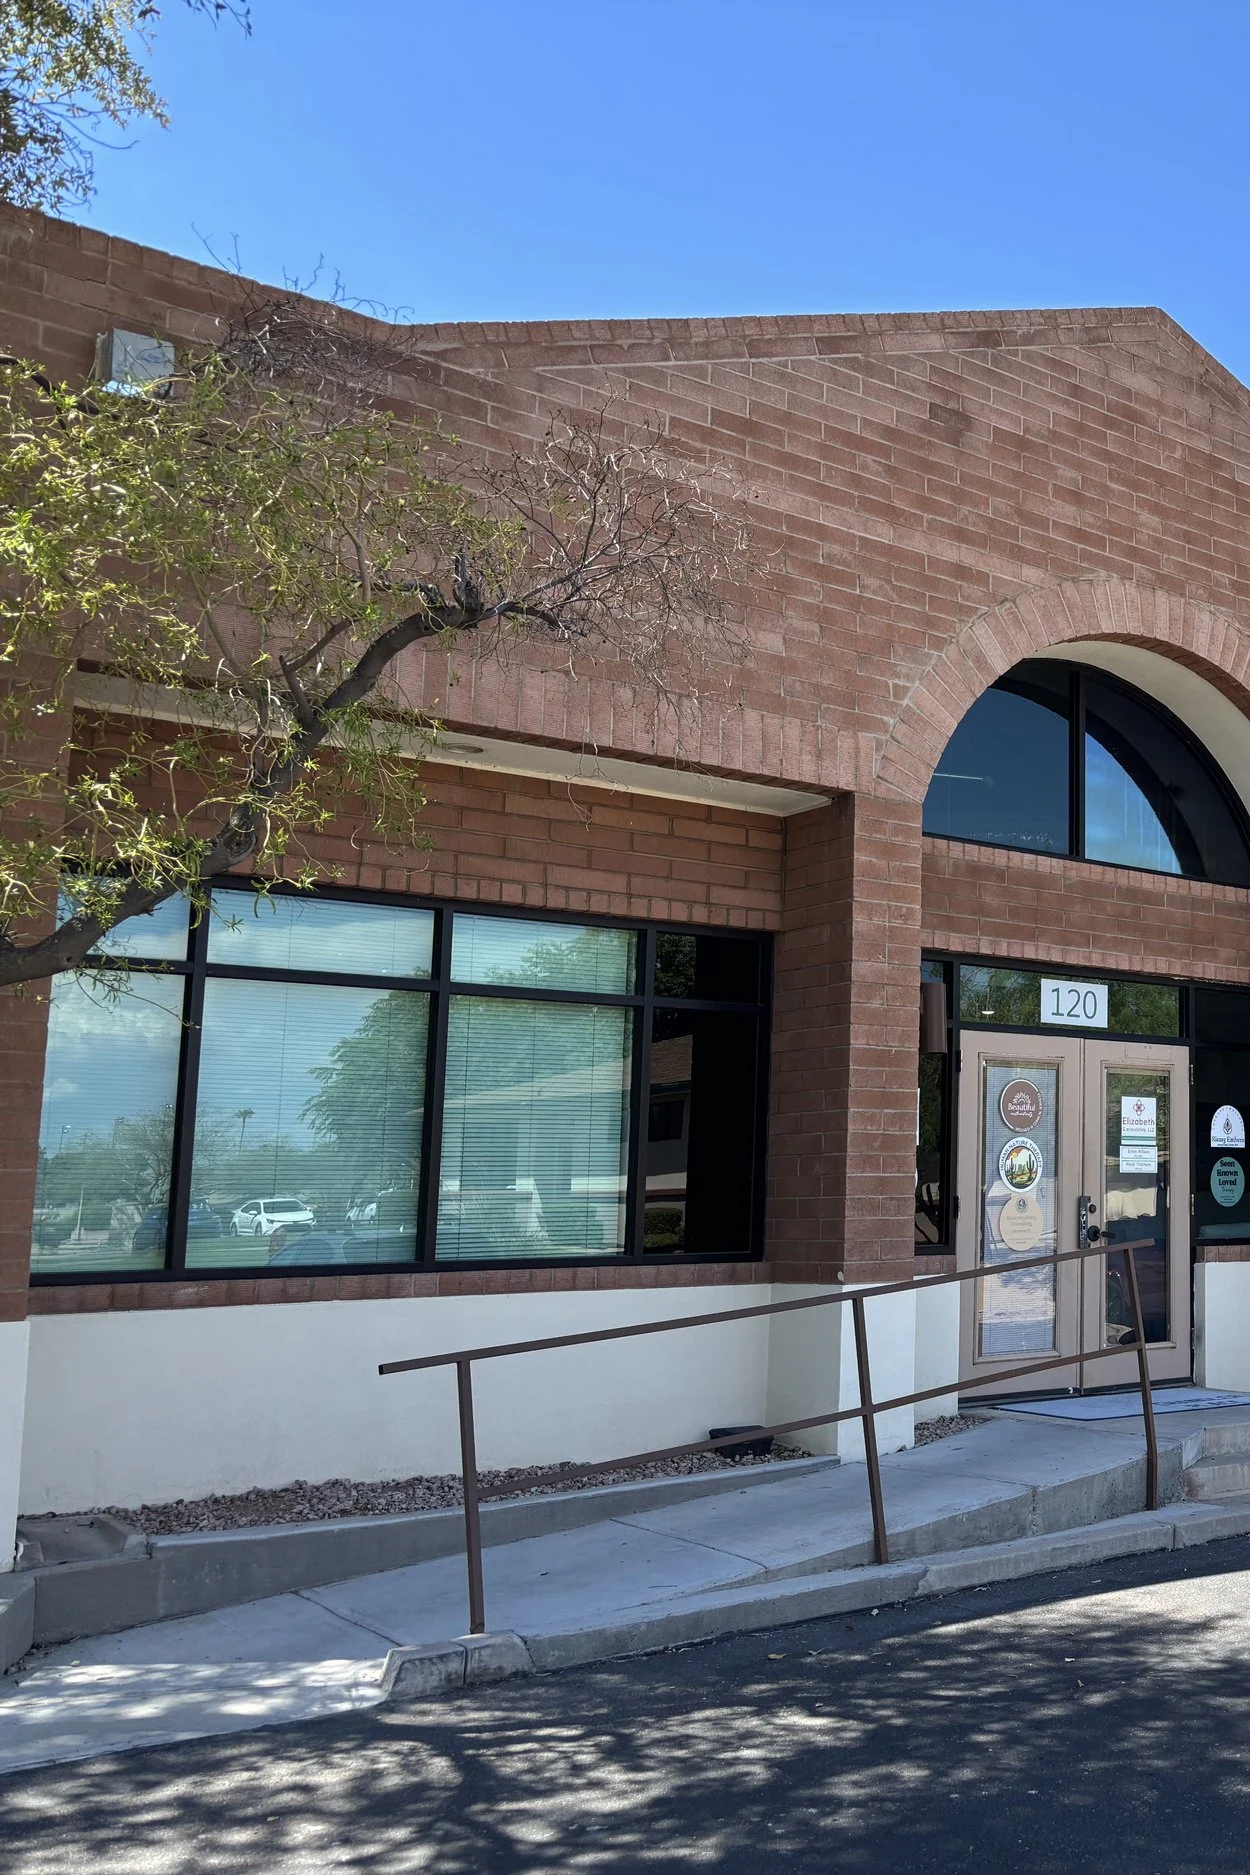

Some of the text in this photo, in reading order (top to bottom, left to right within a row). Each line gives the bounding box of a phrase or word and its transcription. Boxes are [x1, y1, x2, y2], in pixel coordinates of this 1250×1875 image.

[1052, 987, 1097, 1019] 120
[1008, 1102, 1036, 1111] Beautiful
[1122, 1116, 1155, 1126] Elizabeth
[1000, 1140, 1042, 1171] HUMAN NATURE THERAPY
[1220, 1160, 1236, 1168] Seen
[1216, 1169, 1239, 1177] Known
[1218, 1178, 1237, 1186] Loved
